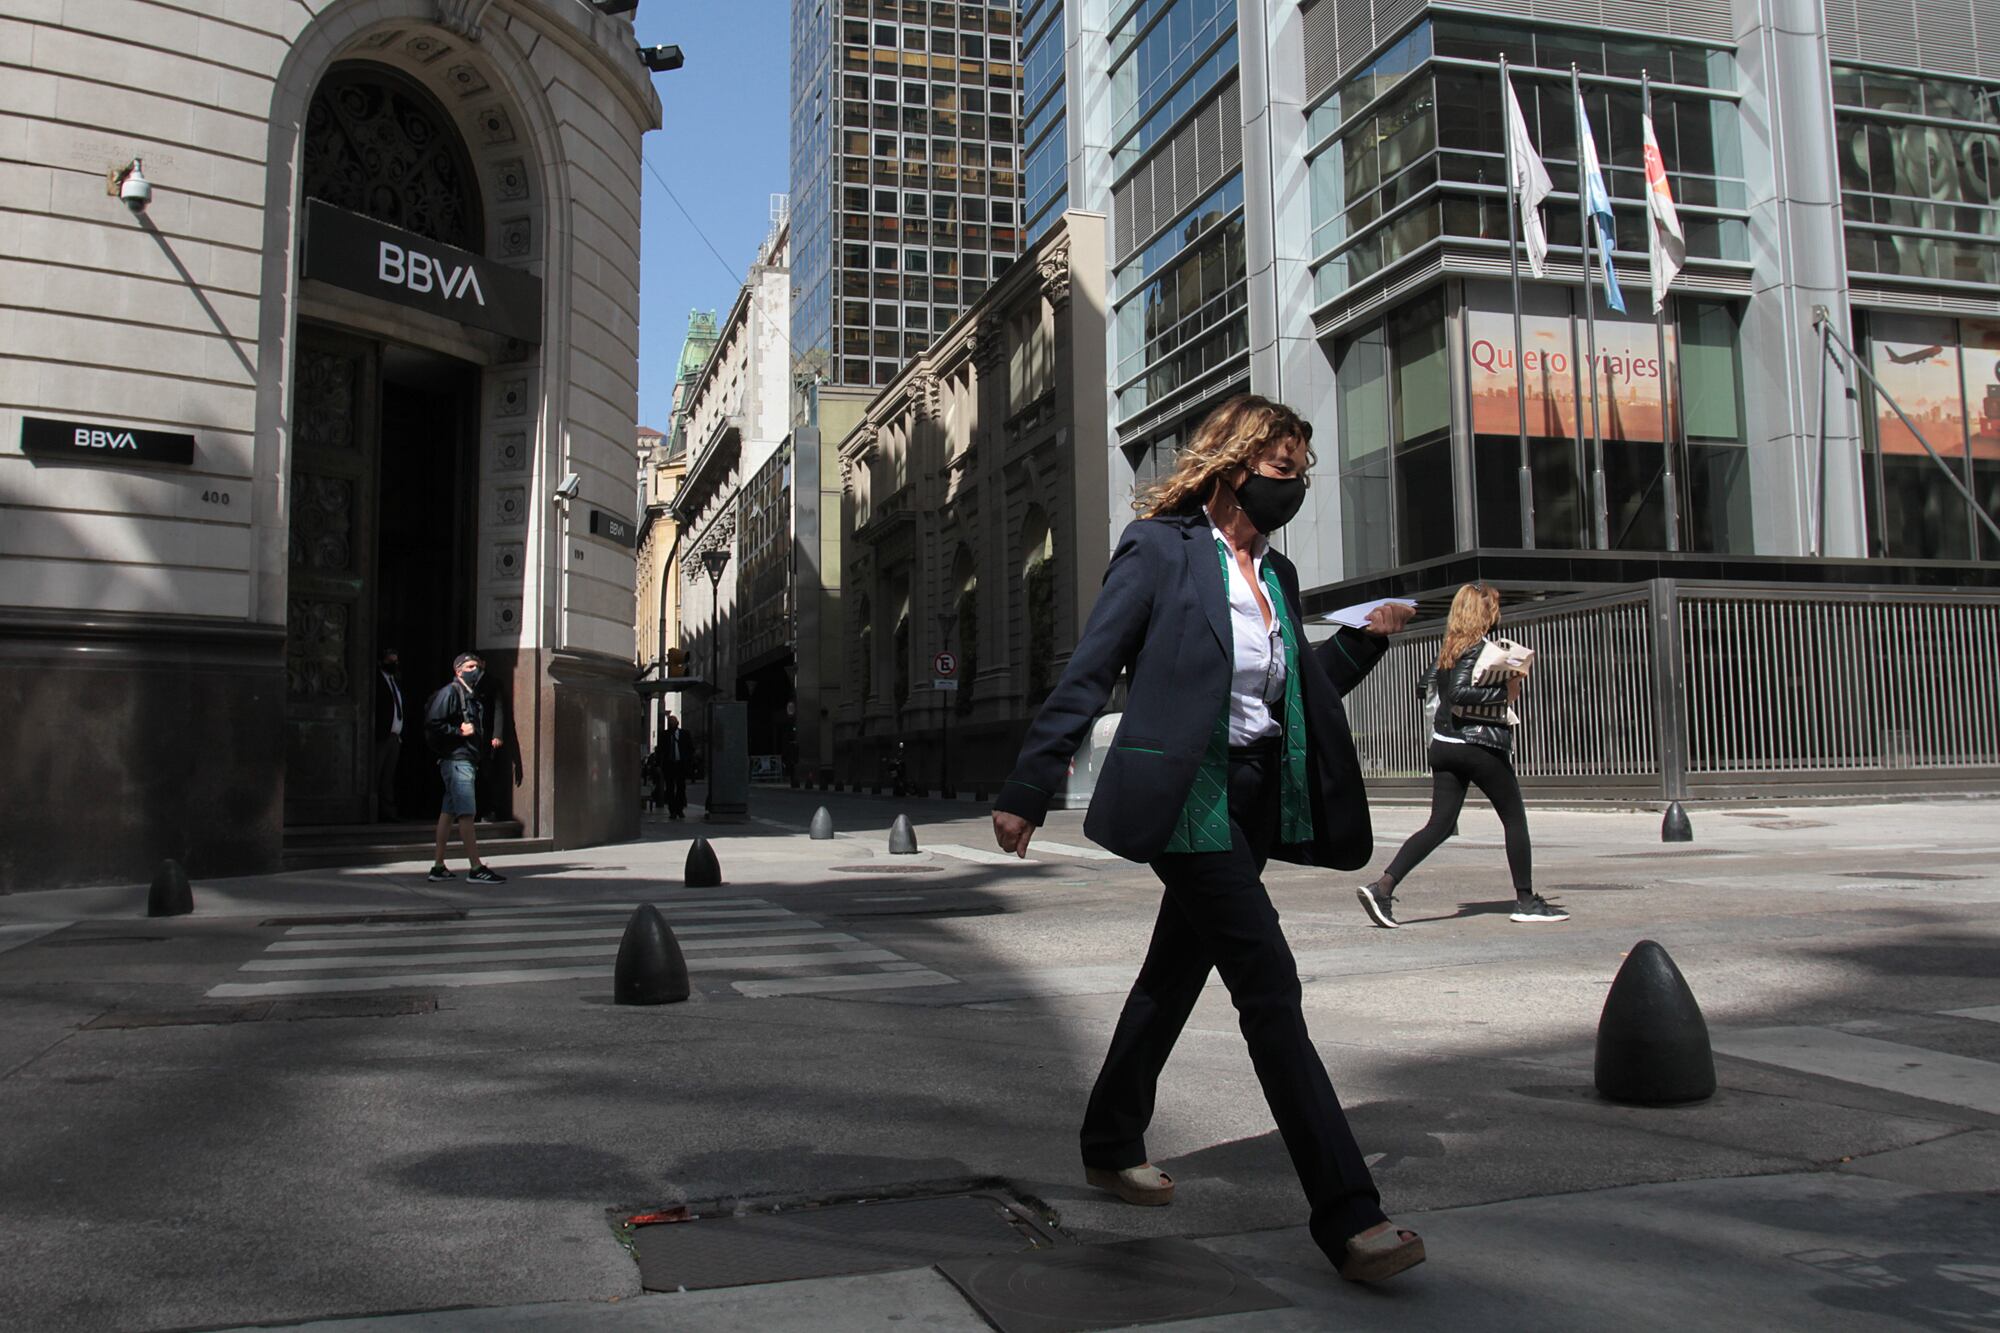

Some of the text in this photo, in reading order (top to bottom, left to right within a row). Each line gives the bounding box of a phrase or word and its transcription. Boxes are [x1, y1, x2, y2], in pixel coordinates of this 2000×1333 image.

[379, 240, 485, 306] BBVA
[1471, 339, 1567, 374] Quero
[74, 428, 138, 449] BBVA
[201, 490, 230, 505] 400
[609, 520, 625, 537] BBVA
